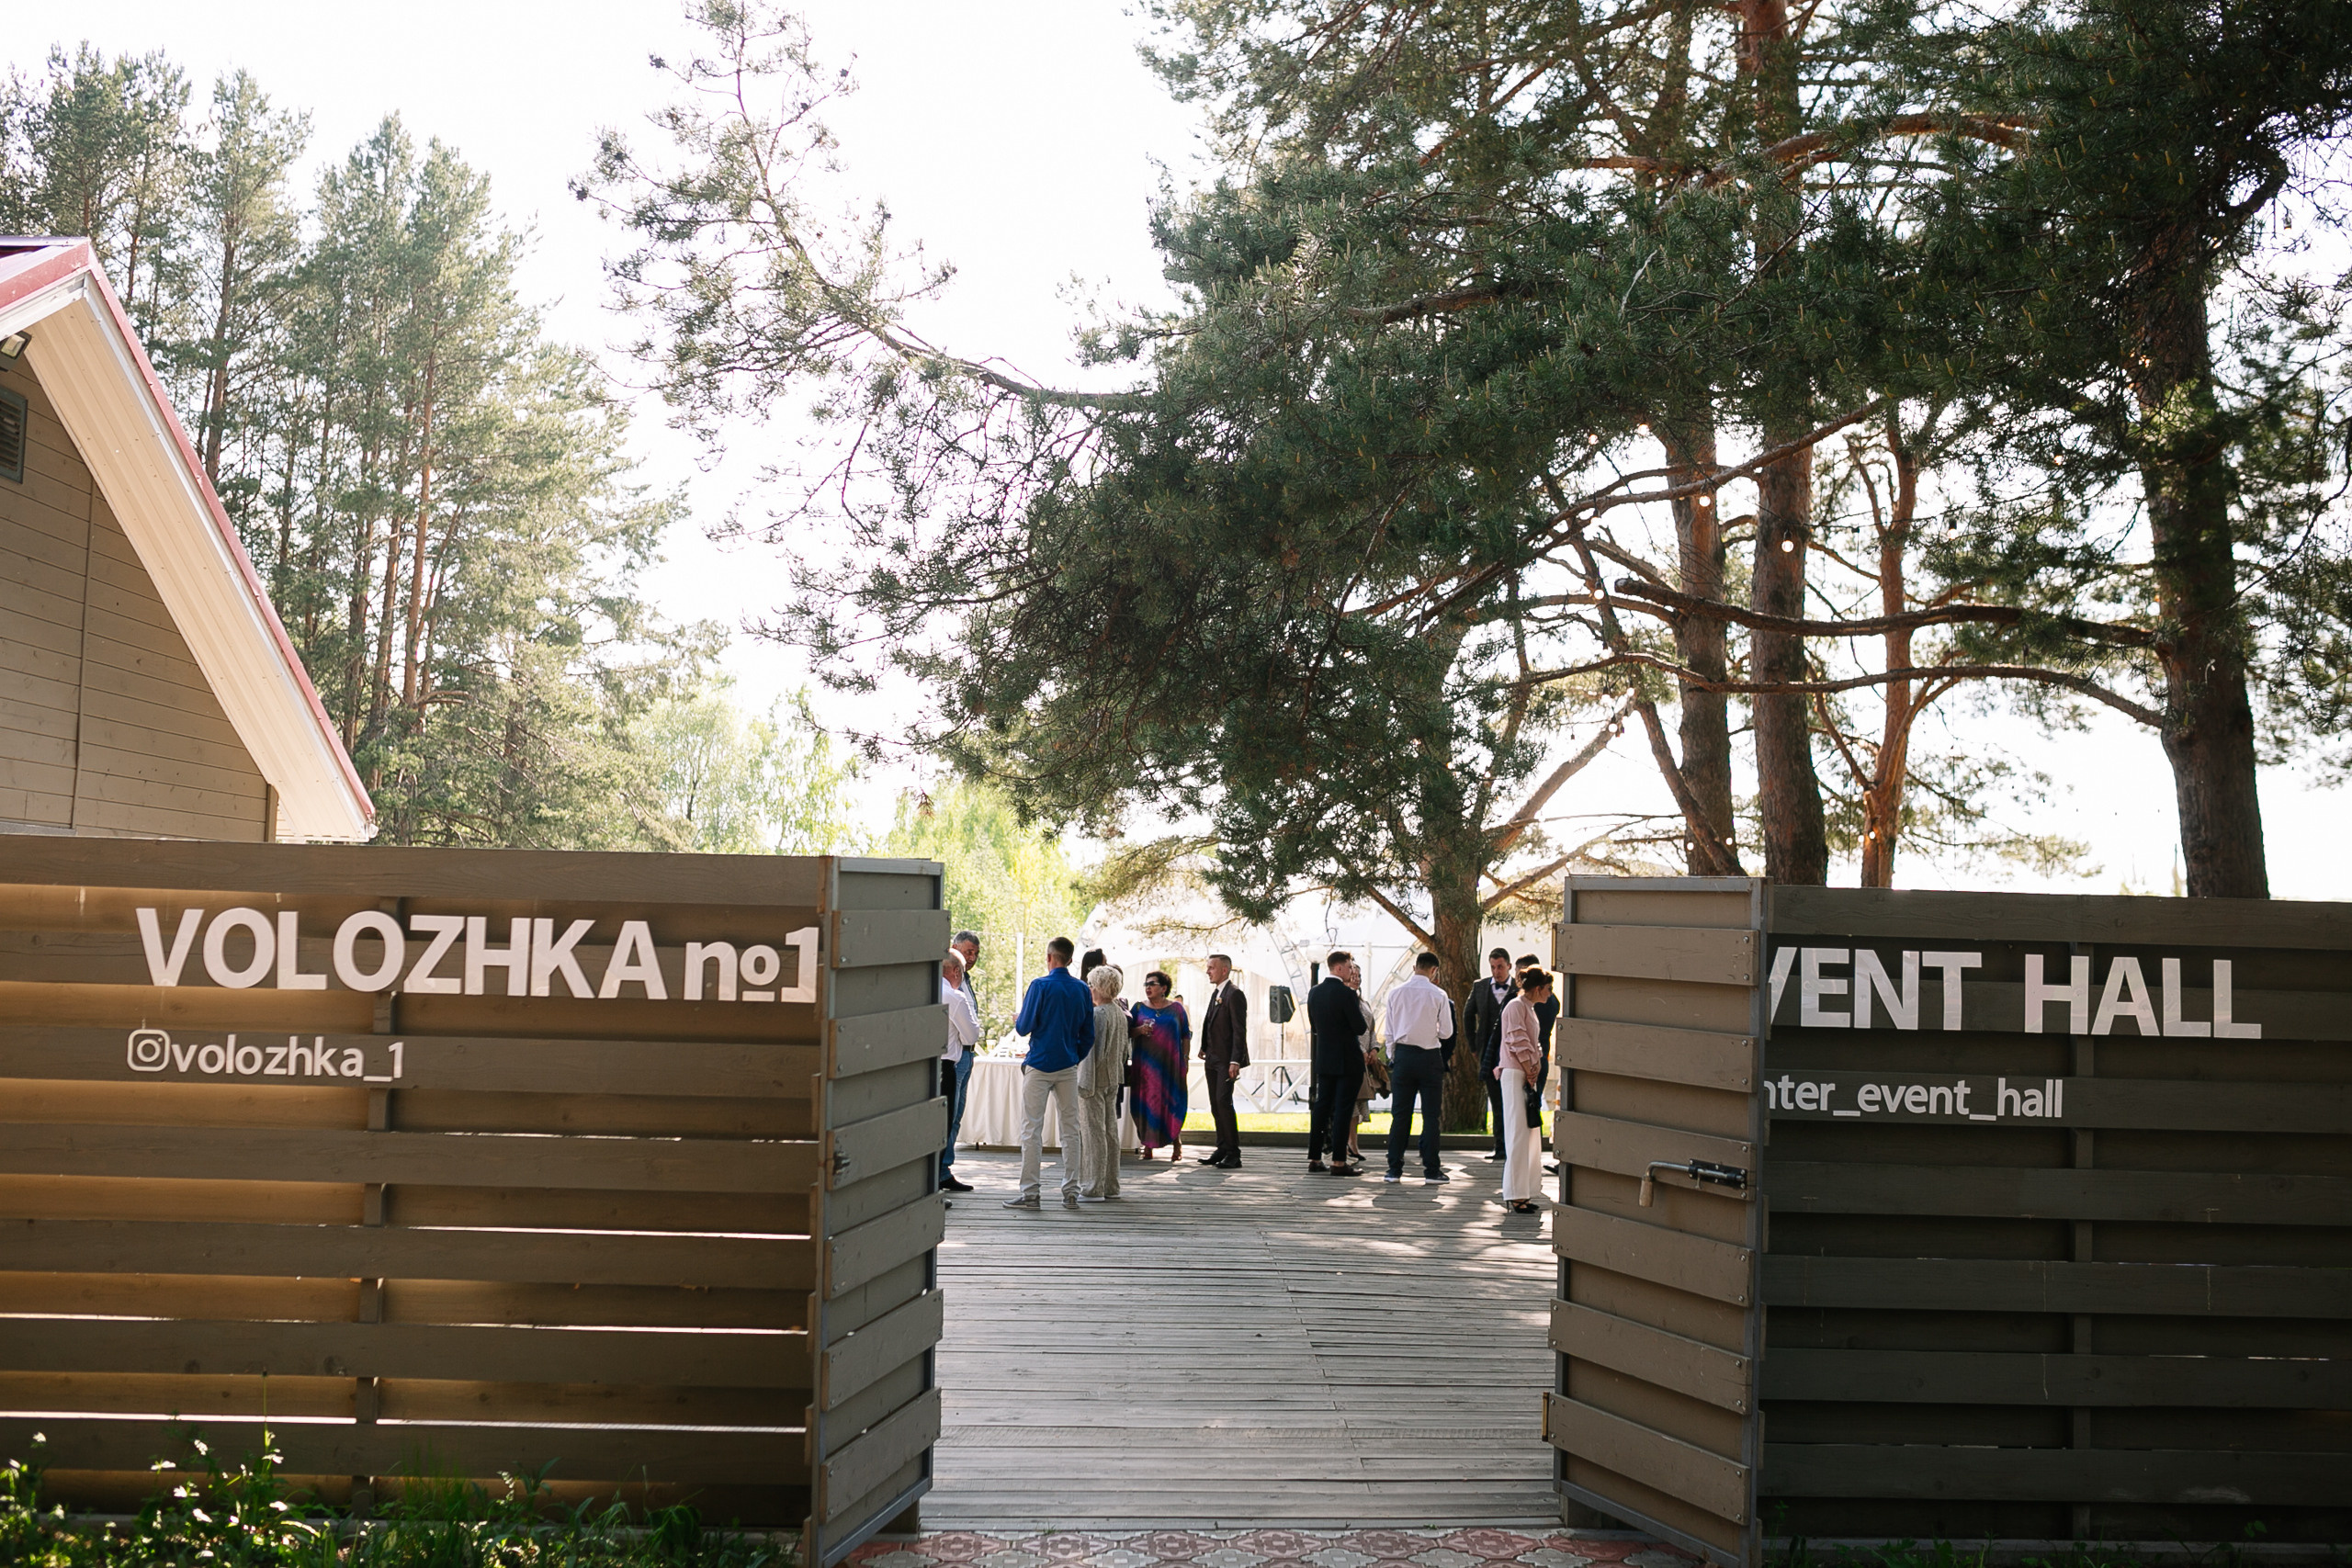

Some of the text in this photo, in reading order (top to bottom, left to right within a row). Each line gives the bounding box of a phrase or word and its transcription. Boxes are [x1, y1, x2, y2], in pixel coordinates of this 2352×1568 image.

[136, 907, 667, 1000] VOLOZHKA
[2025, 954, 2261, 1039] HALL
[171, 1033, 403, 1082] volozhka_1
